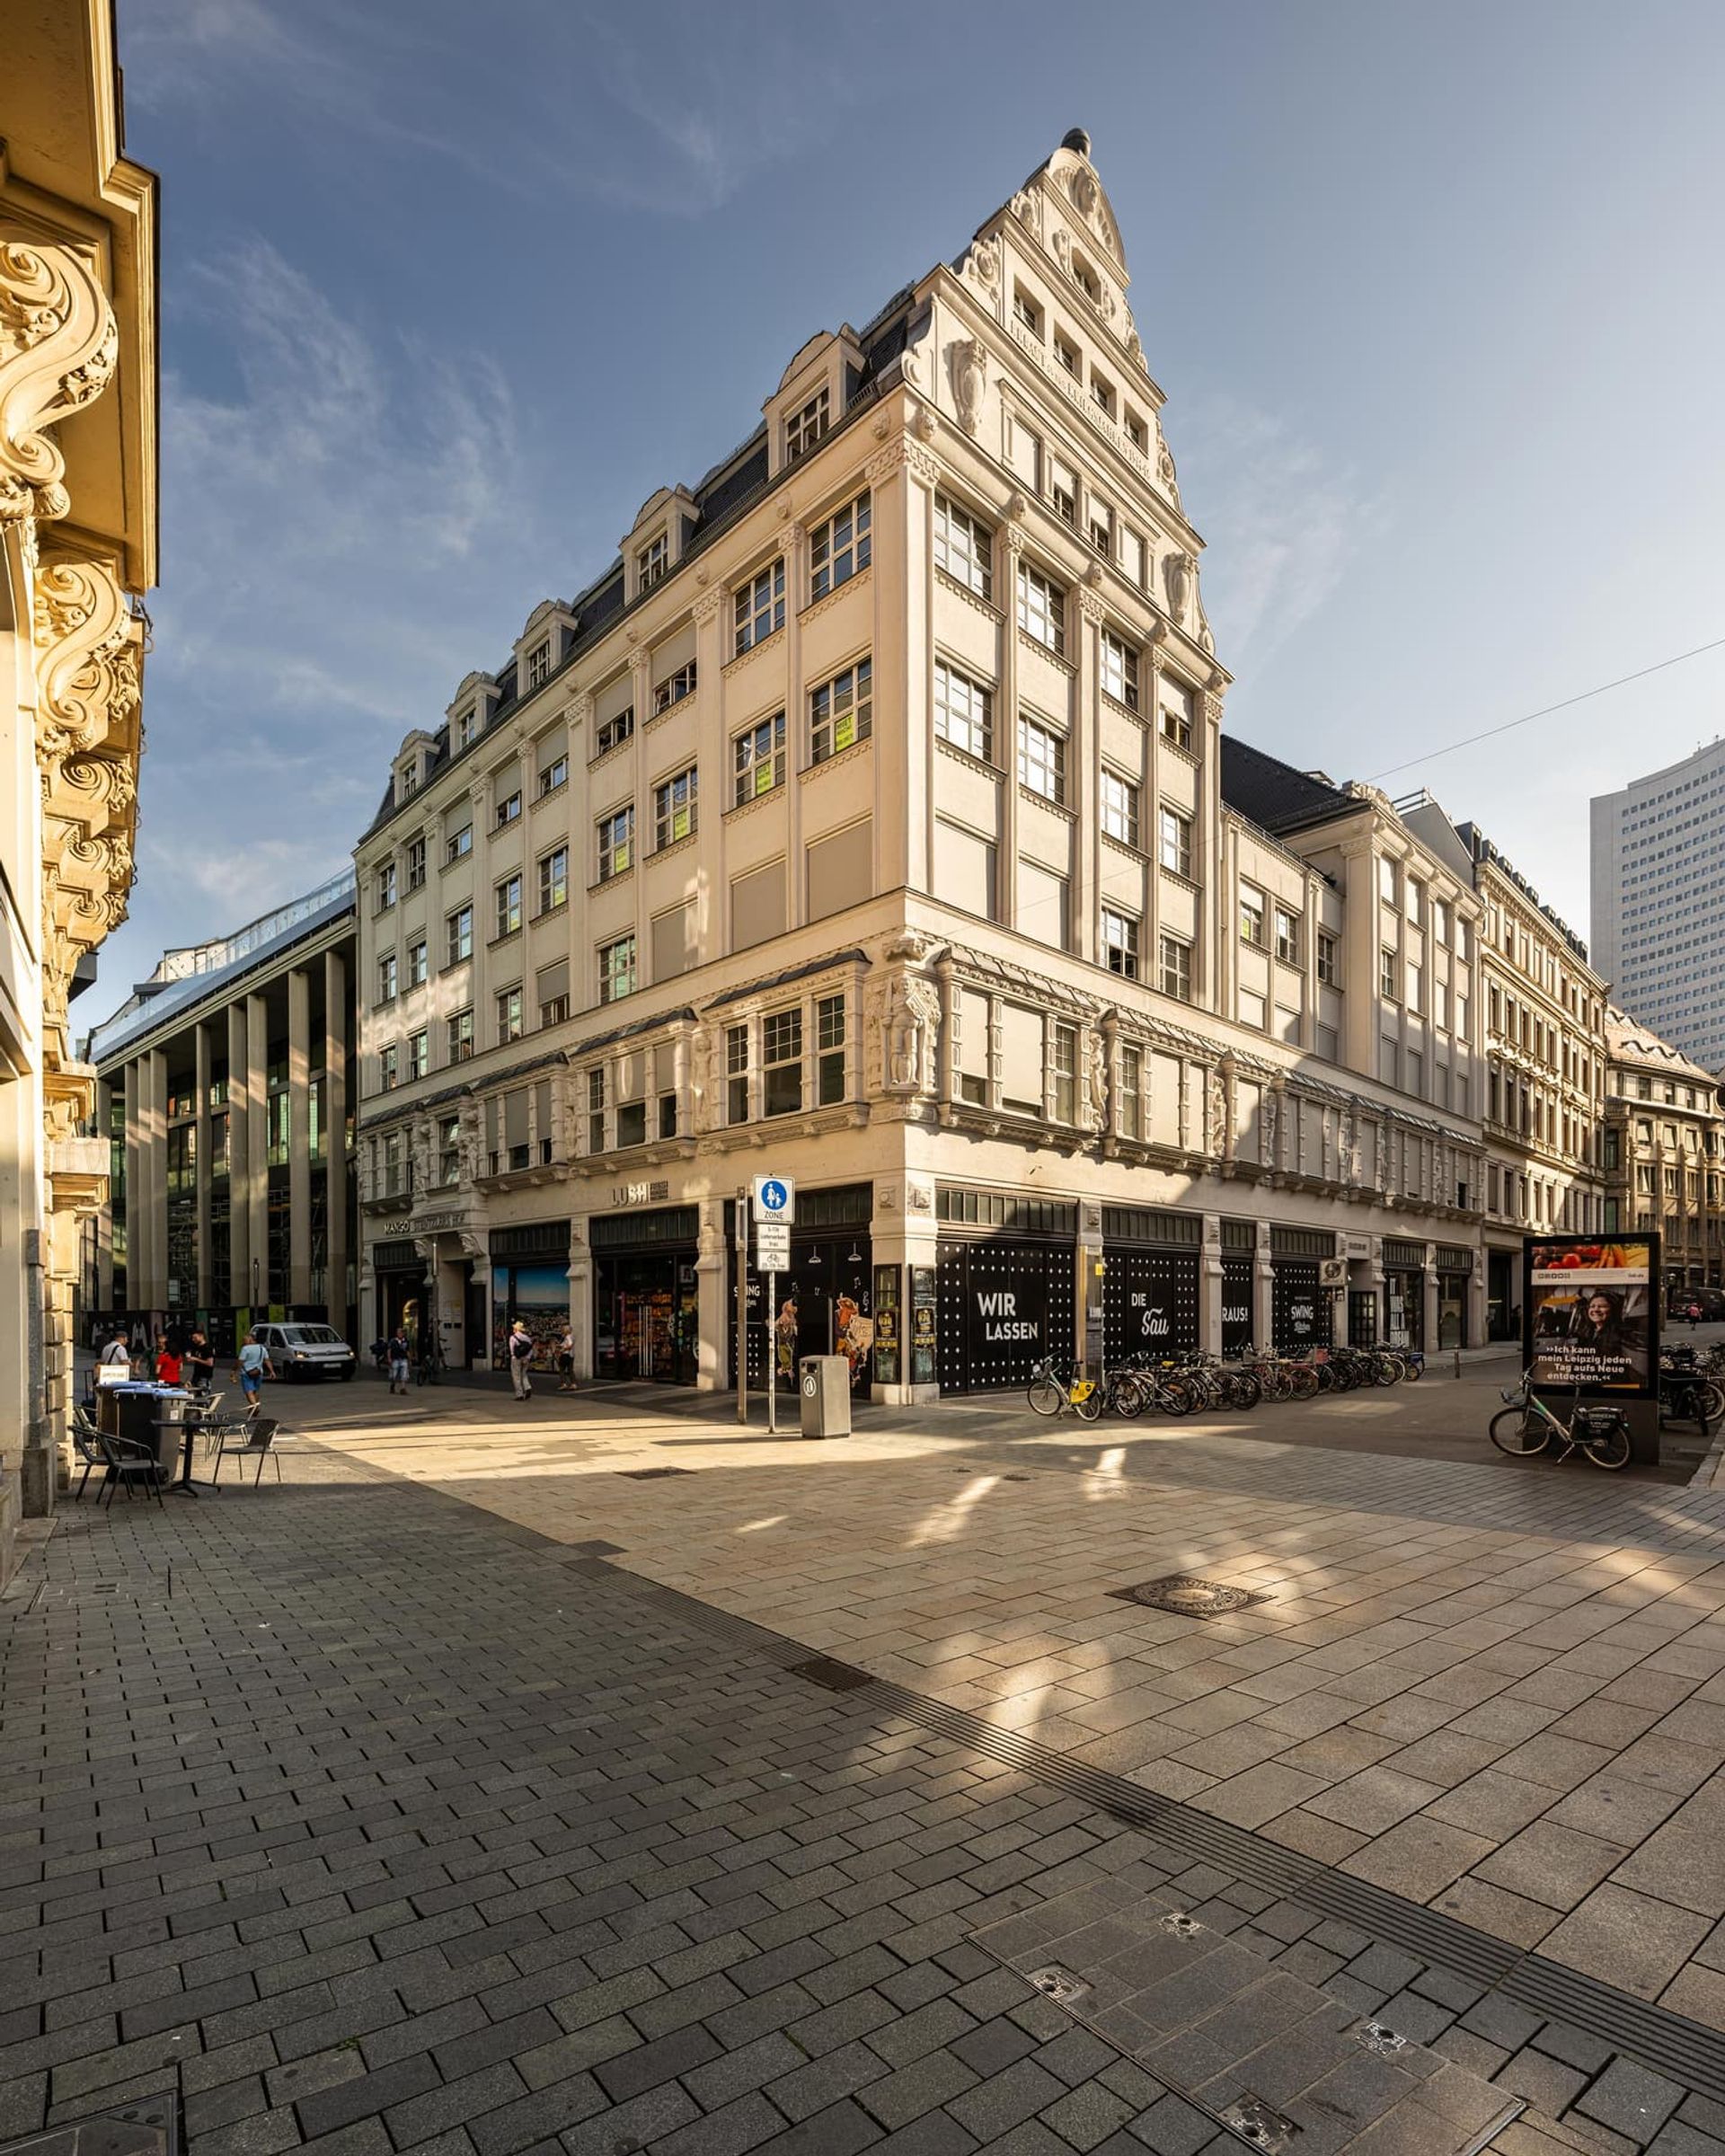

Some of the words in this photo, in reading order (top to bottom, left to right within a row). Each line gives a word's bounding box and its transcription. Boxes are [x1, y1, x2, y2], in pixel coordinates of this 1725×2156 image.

[612, 1182, 650, 1206] LUSH
[764, 1211, 784, 1219] ZONE
[384, 1221, 409, 1235] MANGO
[978, 1293, 1016, 1317] WIR
[1131, 1293, 1146, 1307] DIE
[1222, 1307, 1248, 1322] RAUS!
[1291, 1305, 1314, 1321] SWING
[1141, 1308, 1169, 1336] Sau
[986, 1322, 1038, 1340] LASSEN
[1571, 1346, 1596, 1354] kann
[1564, 1355, 1601, 1364] Leipzig
[1603, 1356, 1632, 1365] jeden
